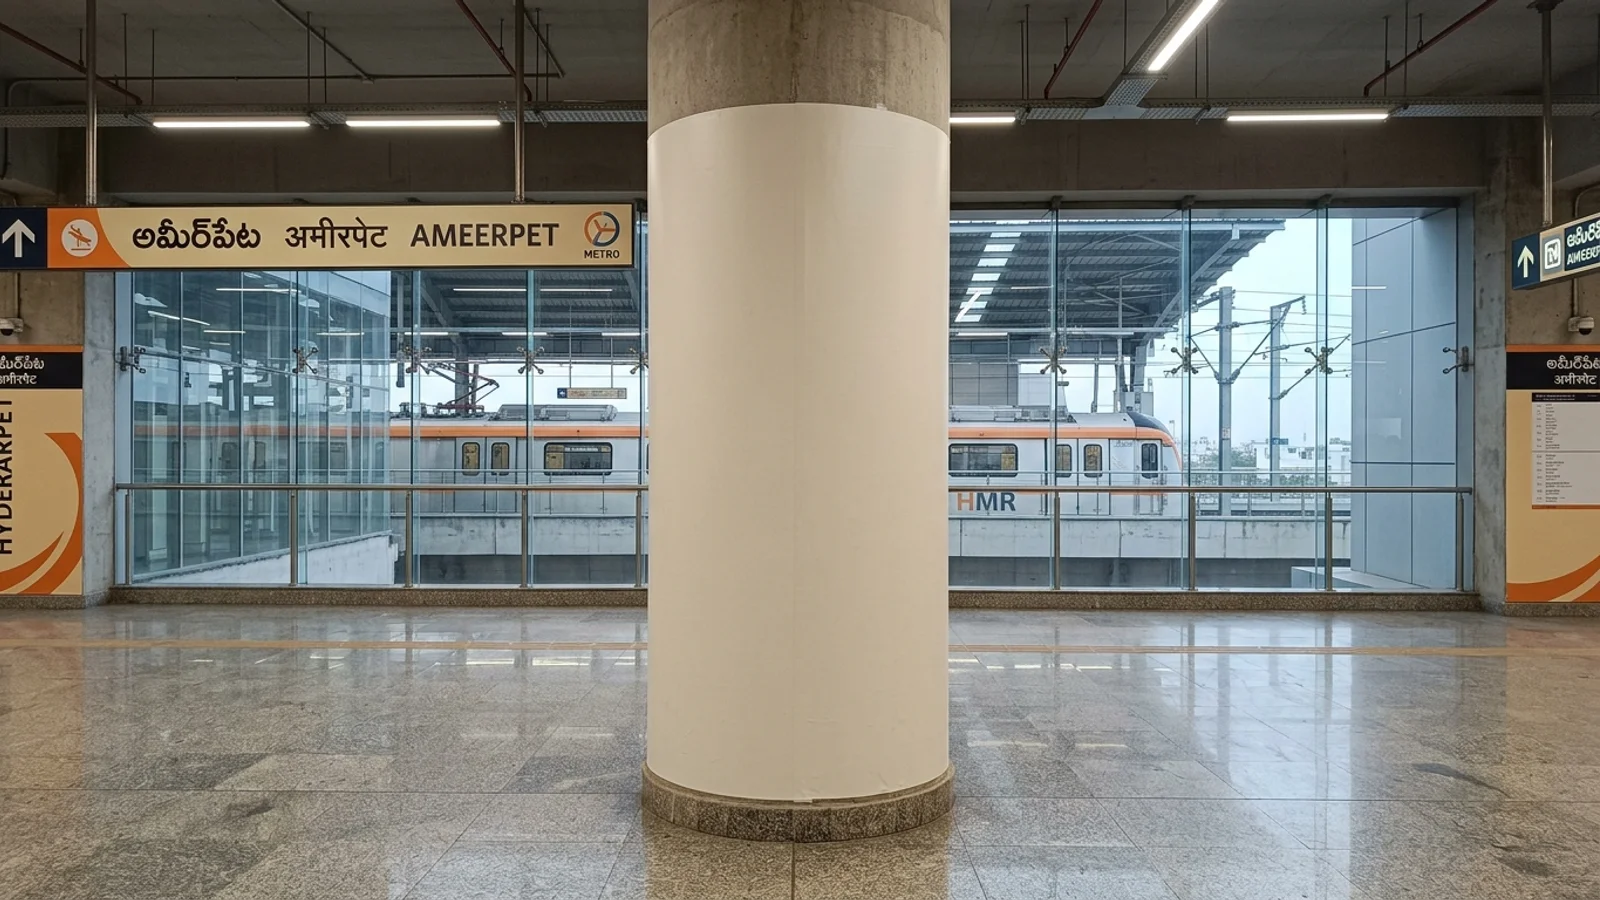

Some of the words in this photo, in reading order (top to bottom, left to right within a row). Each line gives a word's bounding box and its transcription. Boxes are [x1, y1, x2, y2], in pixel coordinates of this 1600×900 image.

[285, 216, 388, 248] अमीरपेट
[410, 223, 559, 247] AMEERPET
[583, 249, 620, 259] METRO
[957, 491, 1016, 511] HMR
